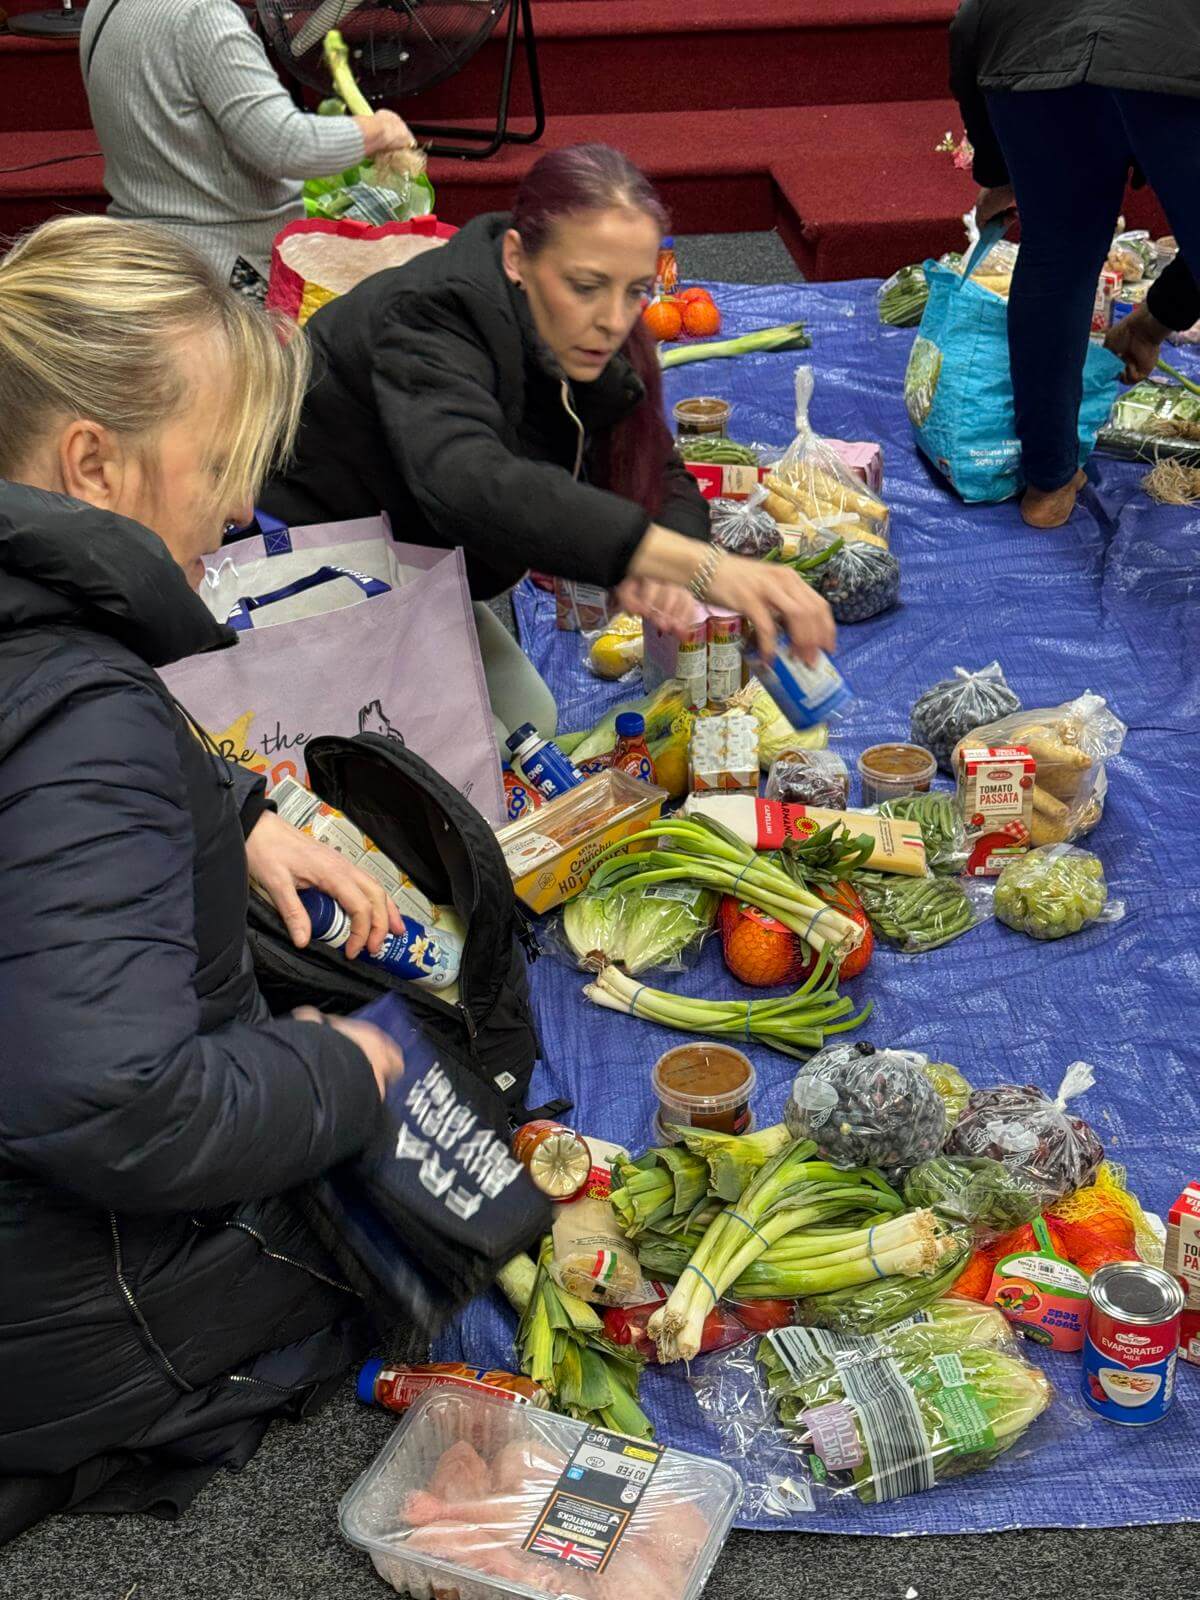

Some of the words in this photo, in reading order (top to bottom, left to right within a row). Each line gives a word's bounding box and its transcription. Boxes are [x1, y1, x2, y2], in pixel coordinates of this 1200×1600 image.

[219, 740, 257, 763] Be
[261, 721, 312, 755] the
[980, 784, 1012, 794] TOMATO
[980, 792, 1019, 805] PASSATA
[1047, 1308, 1079, 1323] Reds
[1041, 1315, 1082, 1332] Sweet
[1102, 1337, 1163, 1355] EVAPORATED
[616, 1465, 633, 1478] FEB
[634, 1471, 646, 1481] 03
[557, 1511, 608, 1532] DRUMSTICKS
[561, 1521, 596, 1536] CHICKEN
